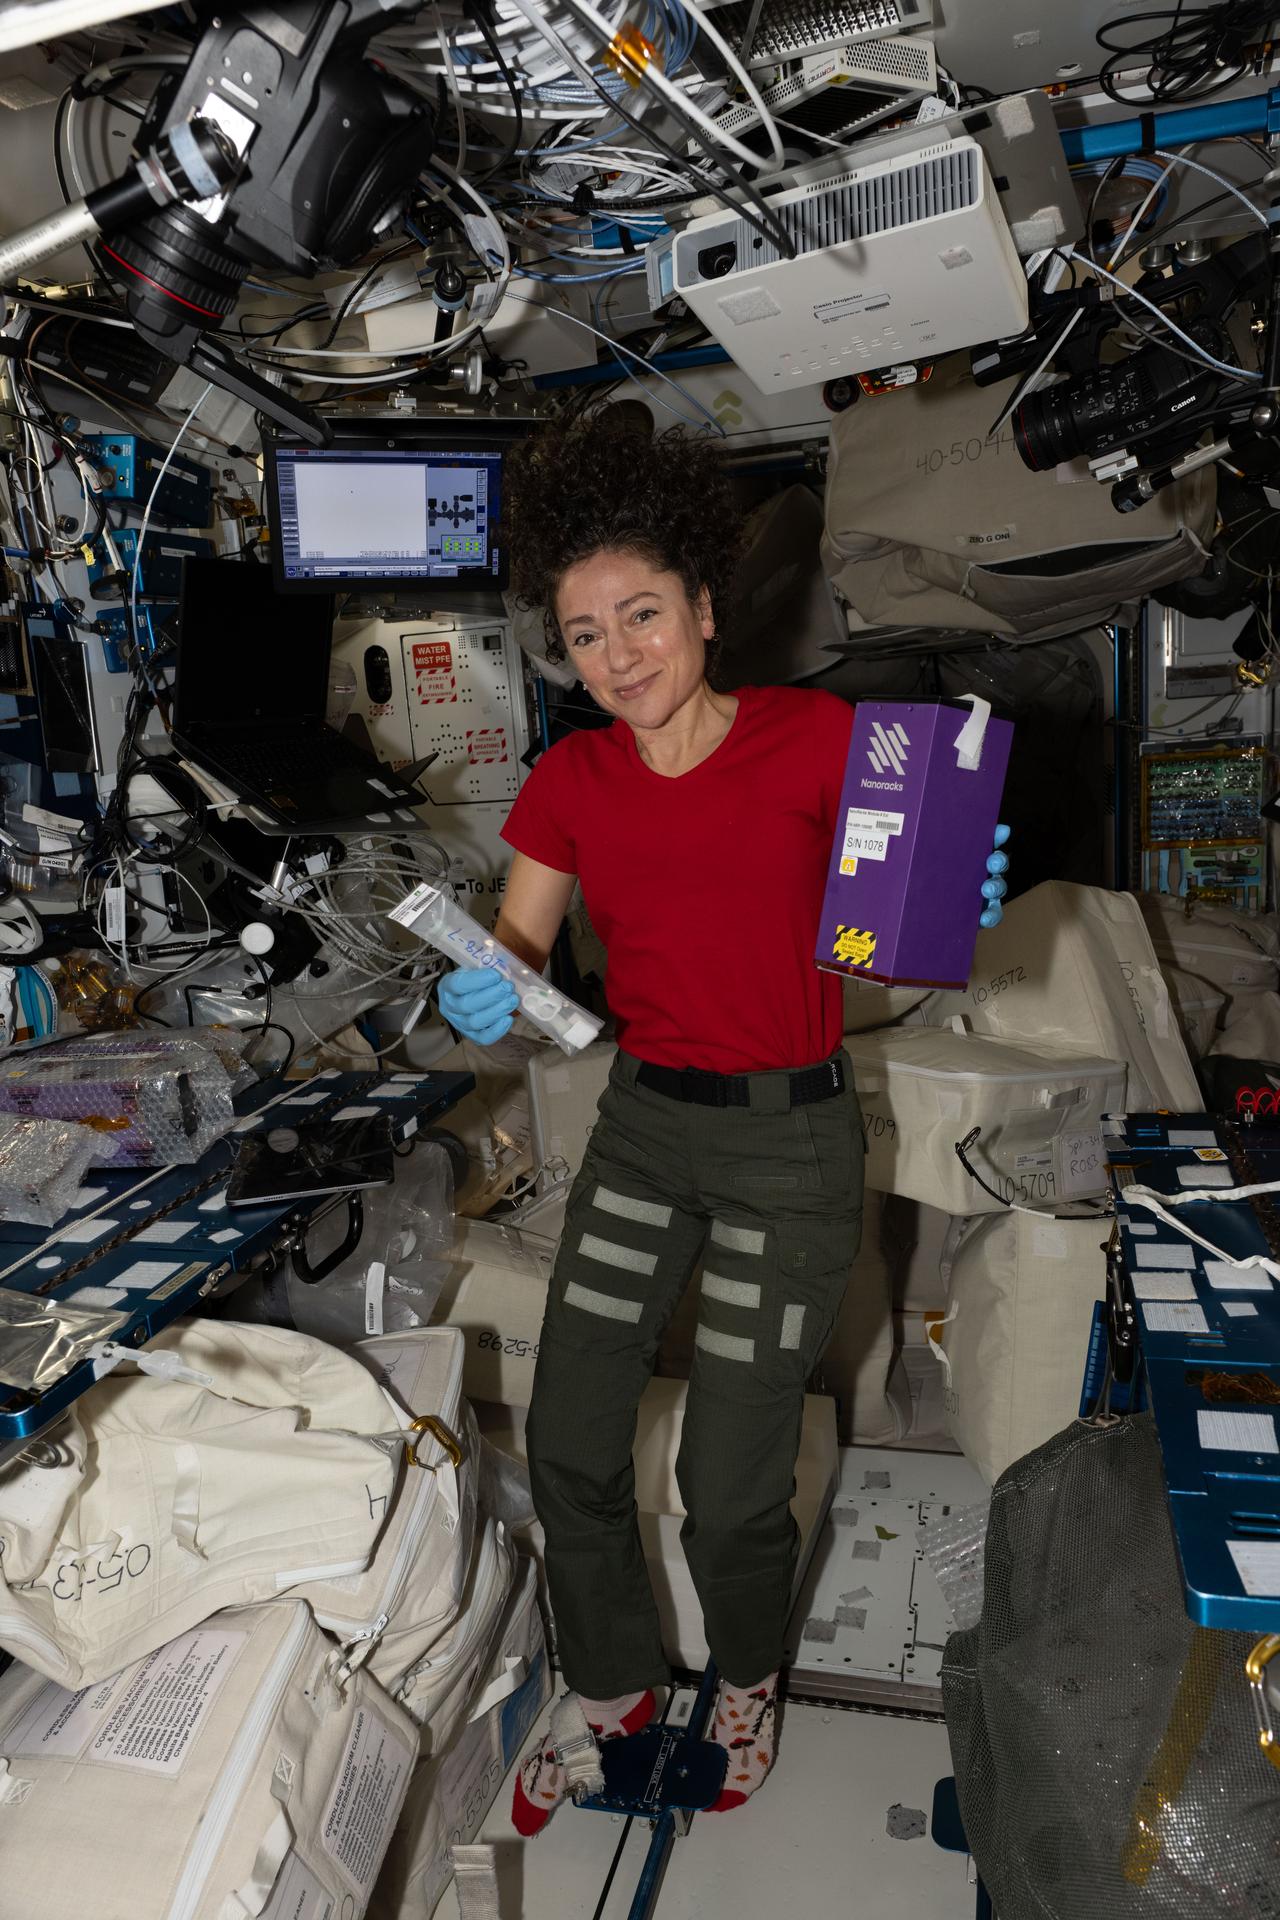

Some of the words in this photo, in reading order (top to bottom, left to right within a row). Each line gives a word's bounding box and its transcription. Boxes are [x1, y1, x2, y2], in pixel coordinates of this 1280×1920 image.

[813, 301, 832, 310] Casio
[833, 294, 863, 304] Projector
[1170, 395, 1196, 412] Canon
[416, 657, 434, 665] MIST
[435, 655, 451, 663] PFE
[417, 646, 446, 654] WATER
[860, 778, 904, 792] Nanoracks
[847, 837, 862, 849] S/N
[864, 840, 884, 852] 1078
[466, 879, 484, 894] To
[844, 936, 868, 946] WARNING
[972, 966, 1027, 1006] 10-5572
[998, 1172, 1056, 1202] 10-5709
[42, 1702, 71, 1742] CORDLESS
[94, 1703, 125, 1749] CORDLESS
[122, 1669, 147, 1704] VACUUM
[112, 1677, 150, 1734] ACCESSORIES
[113, 1743, 122, 1754] 2.0
[120, 1730, 129, 1742] Ahr
[127, 1709, 141, 1730] Makita
[140, 1685, 157, 1709] Battery
[154, 1670, 166, 1685] Pack
[120, 1724, 140, 1756] Cordless
[136, 1697, 156, 1725] Vacuum
[152, 1674, 170, 1698] Cleaner
[127, 1725, 147, 1756] Cordless
[143, 1698, 162, 1725] Vacuum
[159, 1674, 176, 1697] Cleaner
[133, 1726, 154, 1757] Cordless
[150, 1698, 169, 1726] Vacuum
[165, 1674, 183, 1699] Cleaner
[140, 1727, 161, 1758] Cordless
[157, 1698, 175, 1727] Vacuum
[172, 1680, 186, 1700] HEPA
[148, 1727, 168, 1759] Cordless
[164, 1699, 182, 1728] Vacuum
[178, 1682, 192, 1700] Hose
[155, 1728, 174, 1761] Cordless
[171, 1700, 189, 1729] Vacuum
[186, 1683, 198, 1701] Hose
[195, 1661, 211, 1683] Handle
[162, 1738, 178, 1762] Makita
[174, 1712, 191, 1738] Battery
[187, 1694, 200, 1712] Pack
[196, 1665, 215, 1694] Universal
[172, 1727, 191, 1758] Charger
[187, 1700, 204, 1728] Adapter
[324, 1787, 344, 1837] CORDLESS
[340, 1750, 354, 1787] VACUUM
[351, 1711, 364, 1750] CLEANER
[334, 1764, 357, 1826] ACCESSORIES
